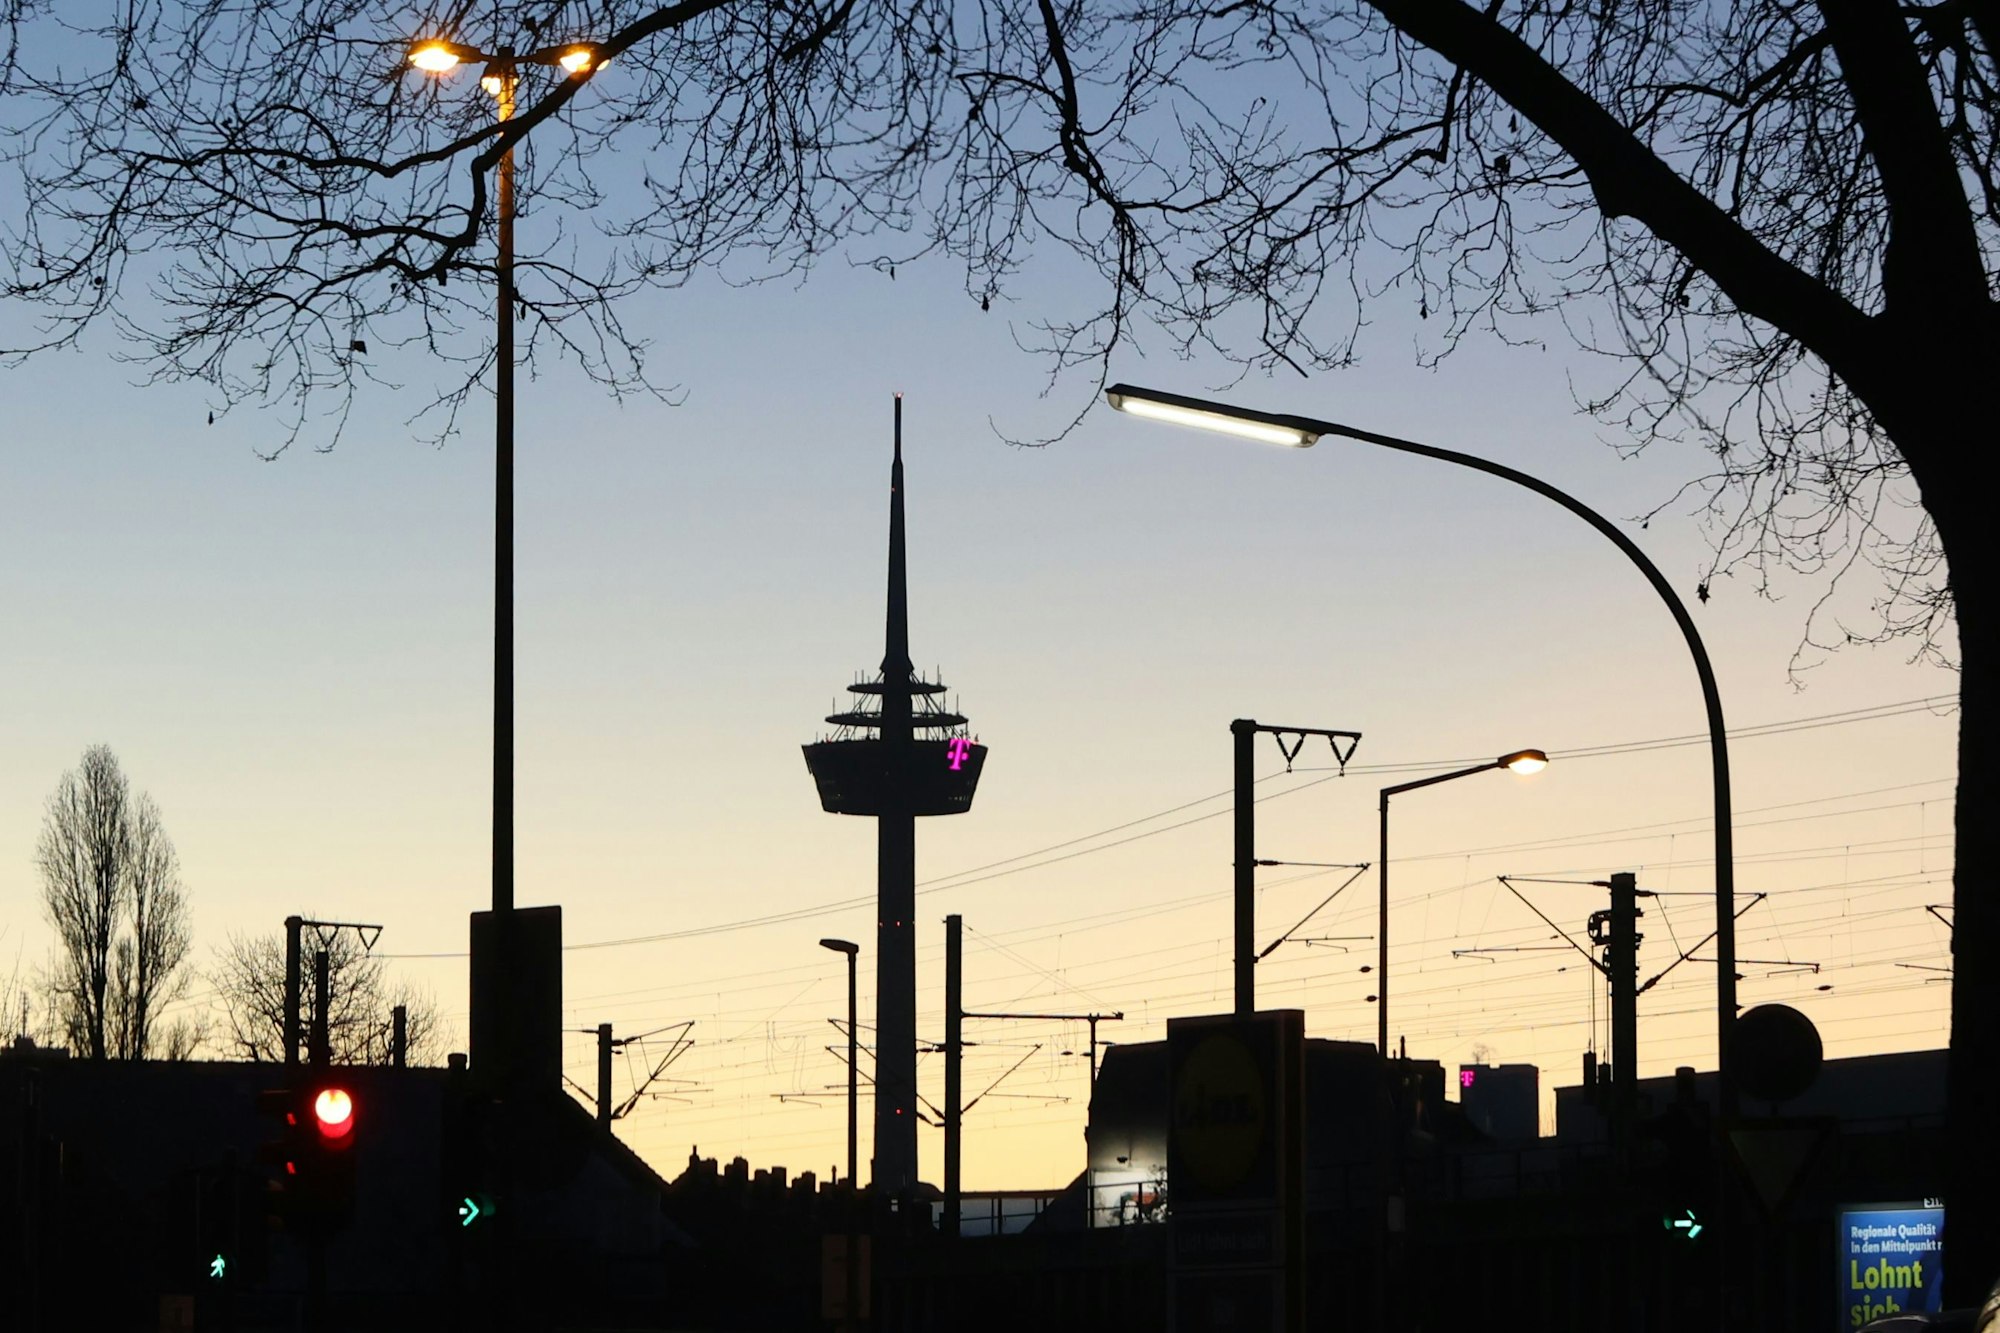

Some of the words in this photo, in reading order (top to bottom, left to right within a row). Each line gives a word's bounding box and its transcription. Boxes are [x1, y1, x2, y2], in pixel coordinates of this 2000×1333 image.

[947, 738, 970, 770] T
[1461, 1071, 1474, 1087] T
[1851, 1225, 1897, 1240] Regionale
[1898, 1223, 1936, 1239] Qualität
[1862, 1241, 1880, 1253] den
[1881, 1239, 1936, 1254] Mittelpunkt
[1851, 1257, 1923, 1290] Lohnt
